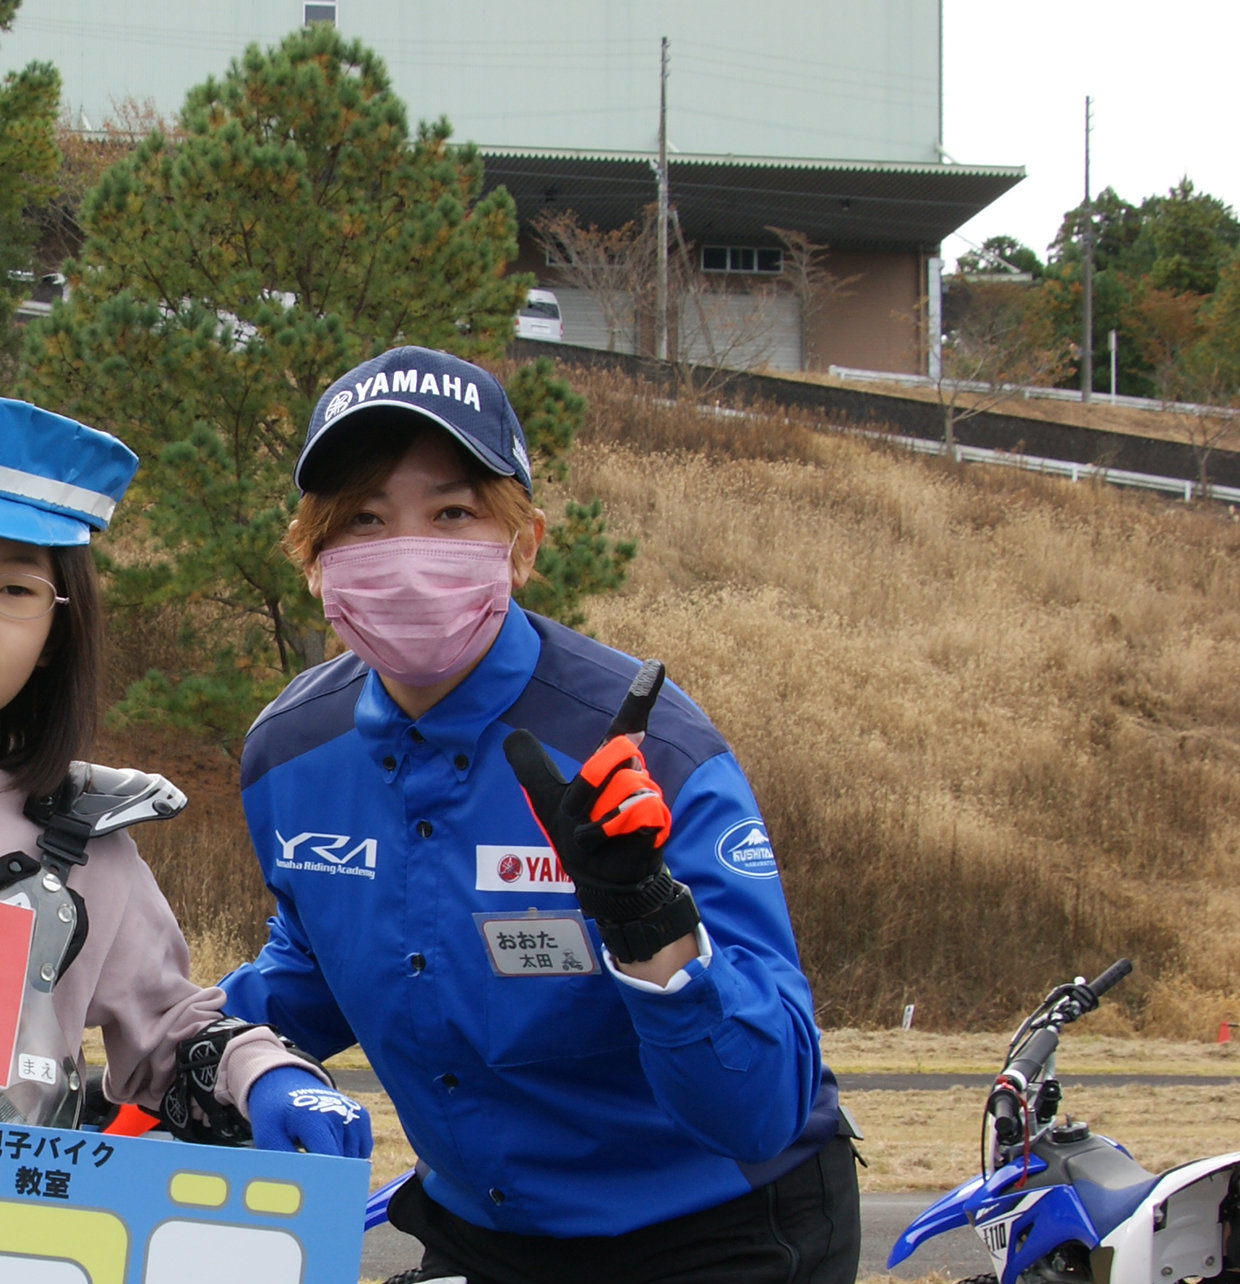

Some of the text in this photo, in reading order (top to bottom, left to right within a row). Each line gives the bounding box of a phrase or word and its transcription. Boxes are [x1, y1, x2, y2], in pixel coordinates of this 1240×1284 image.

[355, 369, 481, 412] YAMAHA
[274, 829, 378, 868] YRA
[303, 861, 337, 875] Riding
[337, 865, 376, 880] Academy
[496, 931, 558, 950] おおた
[519, 953, 554, 969] 太田
[22, 1059, 53, 1080] まえ
[15, 1166, 71, 1199] 教室
